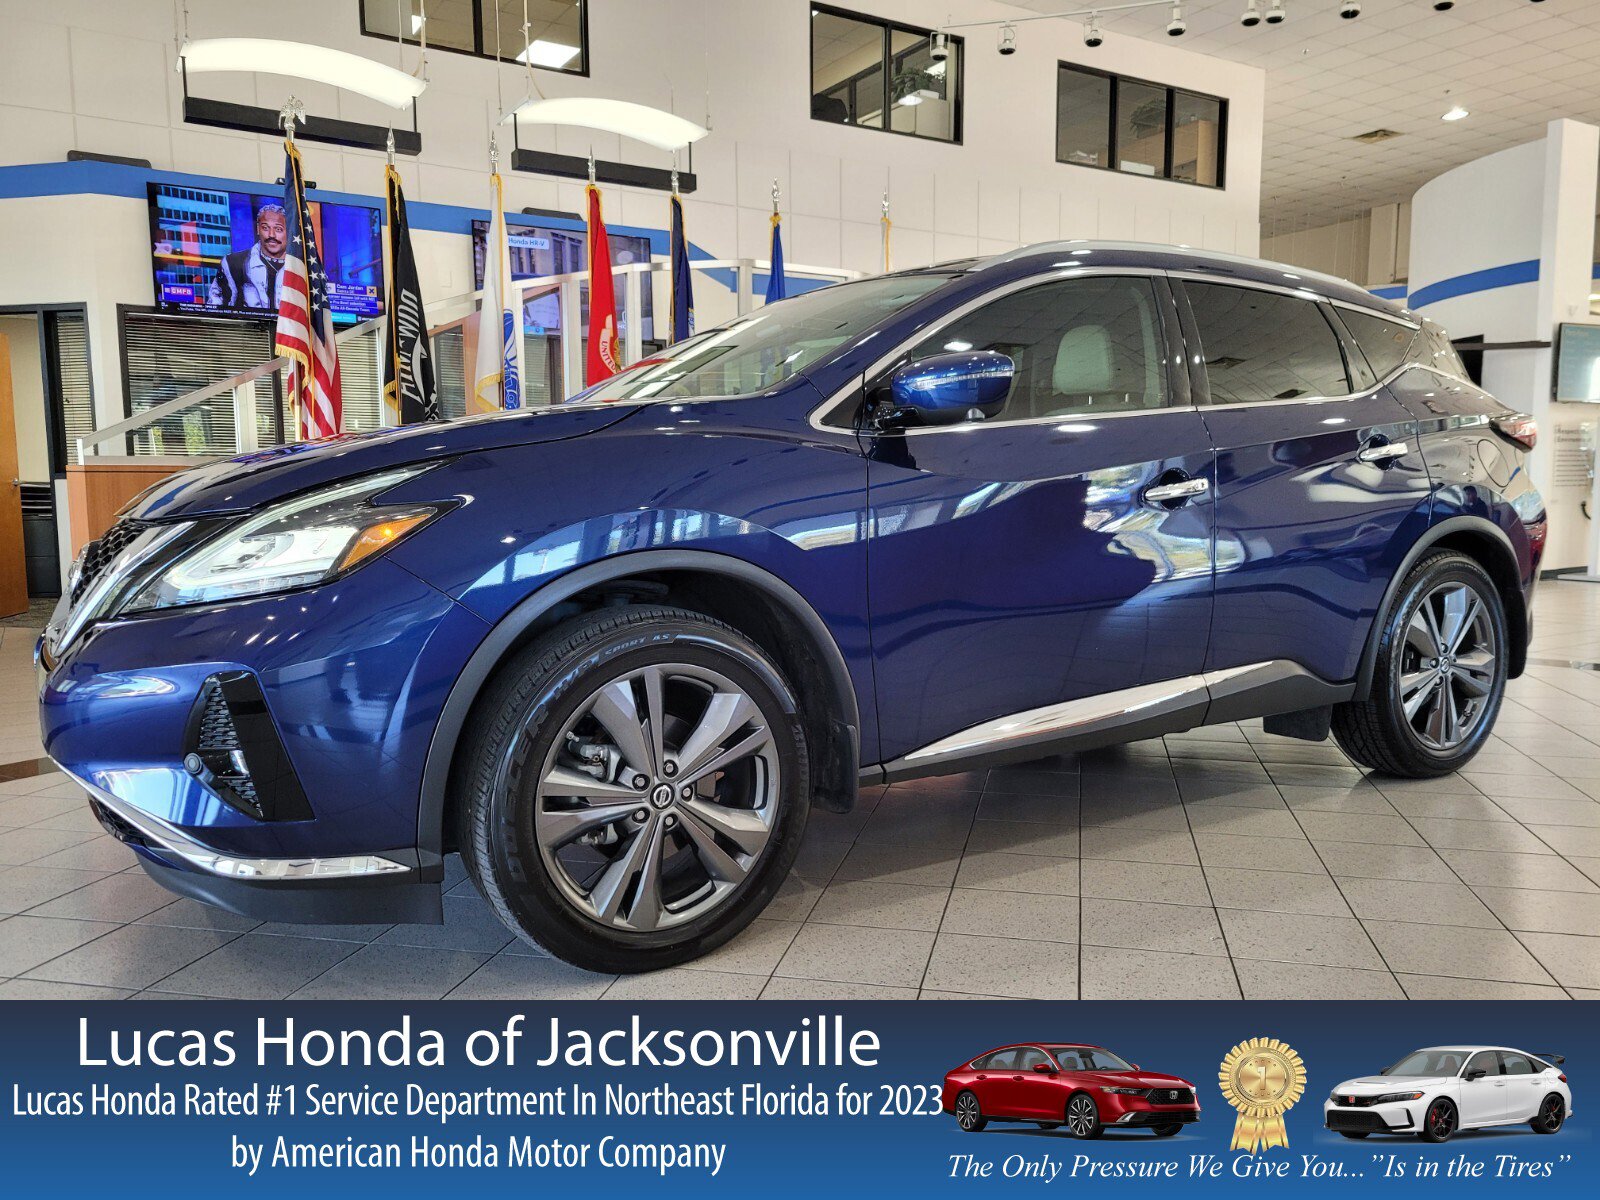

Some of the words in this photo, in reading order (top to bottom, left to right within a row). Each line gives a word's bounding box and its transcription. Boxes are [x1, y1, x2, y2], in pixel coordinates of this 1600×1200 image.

[508, 237, 528, 245] Honda
[604, 636, 648, 655] SPORT
[652, 633, 671, 641] AS
